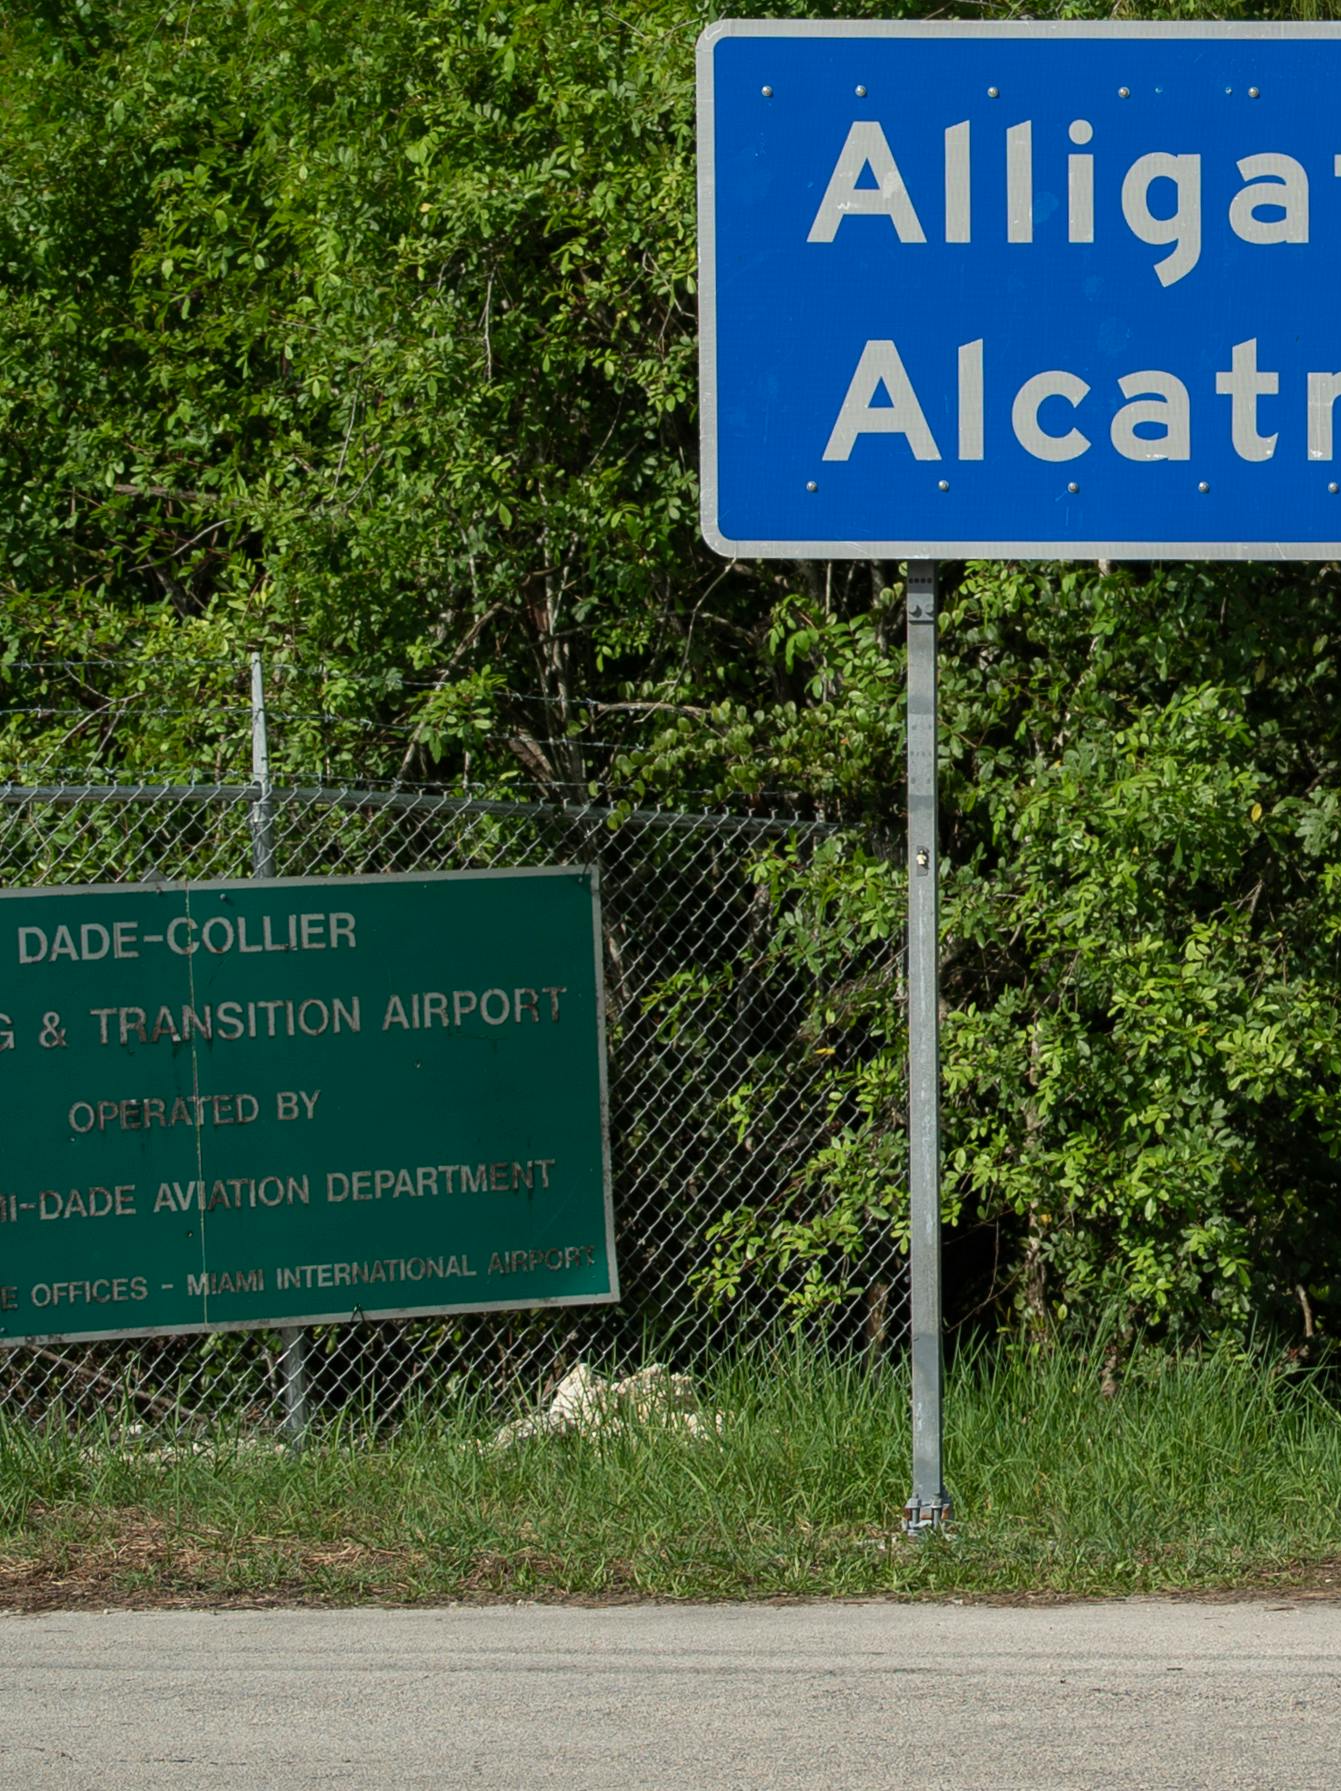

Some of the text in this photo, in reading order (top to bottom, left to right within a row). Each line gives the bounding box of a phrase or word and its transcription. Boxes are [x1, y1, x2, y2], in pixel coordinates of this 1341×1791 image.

[17, 912, 358, 965] DADE-COLLIER
[39, 1011, 68, 1048] &
[90, 997, 361, 1046] TRANSITION
[382, 986, 568, 1032] AIRPORT
[68, 1090, 322, 1134] OPERATED BY
[0, 1158, 556, 1223] I-DADE AVIATION DEPARTMENT
[31, 1276, 149, 1308] OFFICES
[187, 1270, 264, 1297] MIAMI
[276, 1254, 477, 1291] INTERNATIONAL
[487, 1245, 598, 1276] AIRPORT
